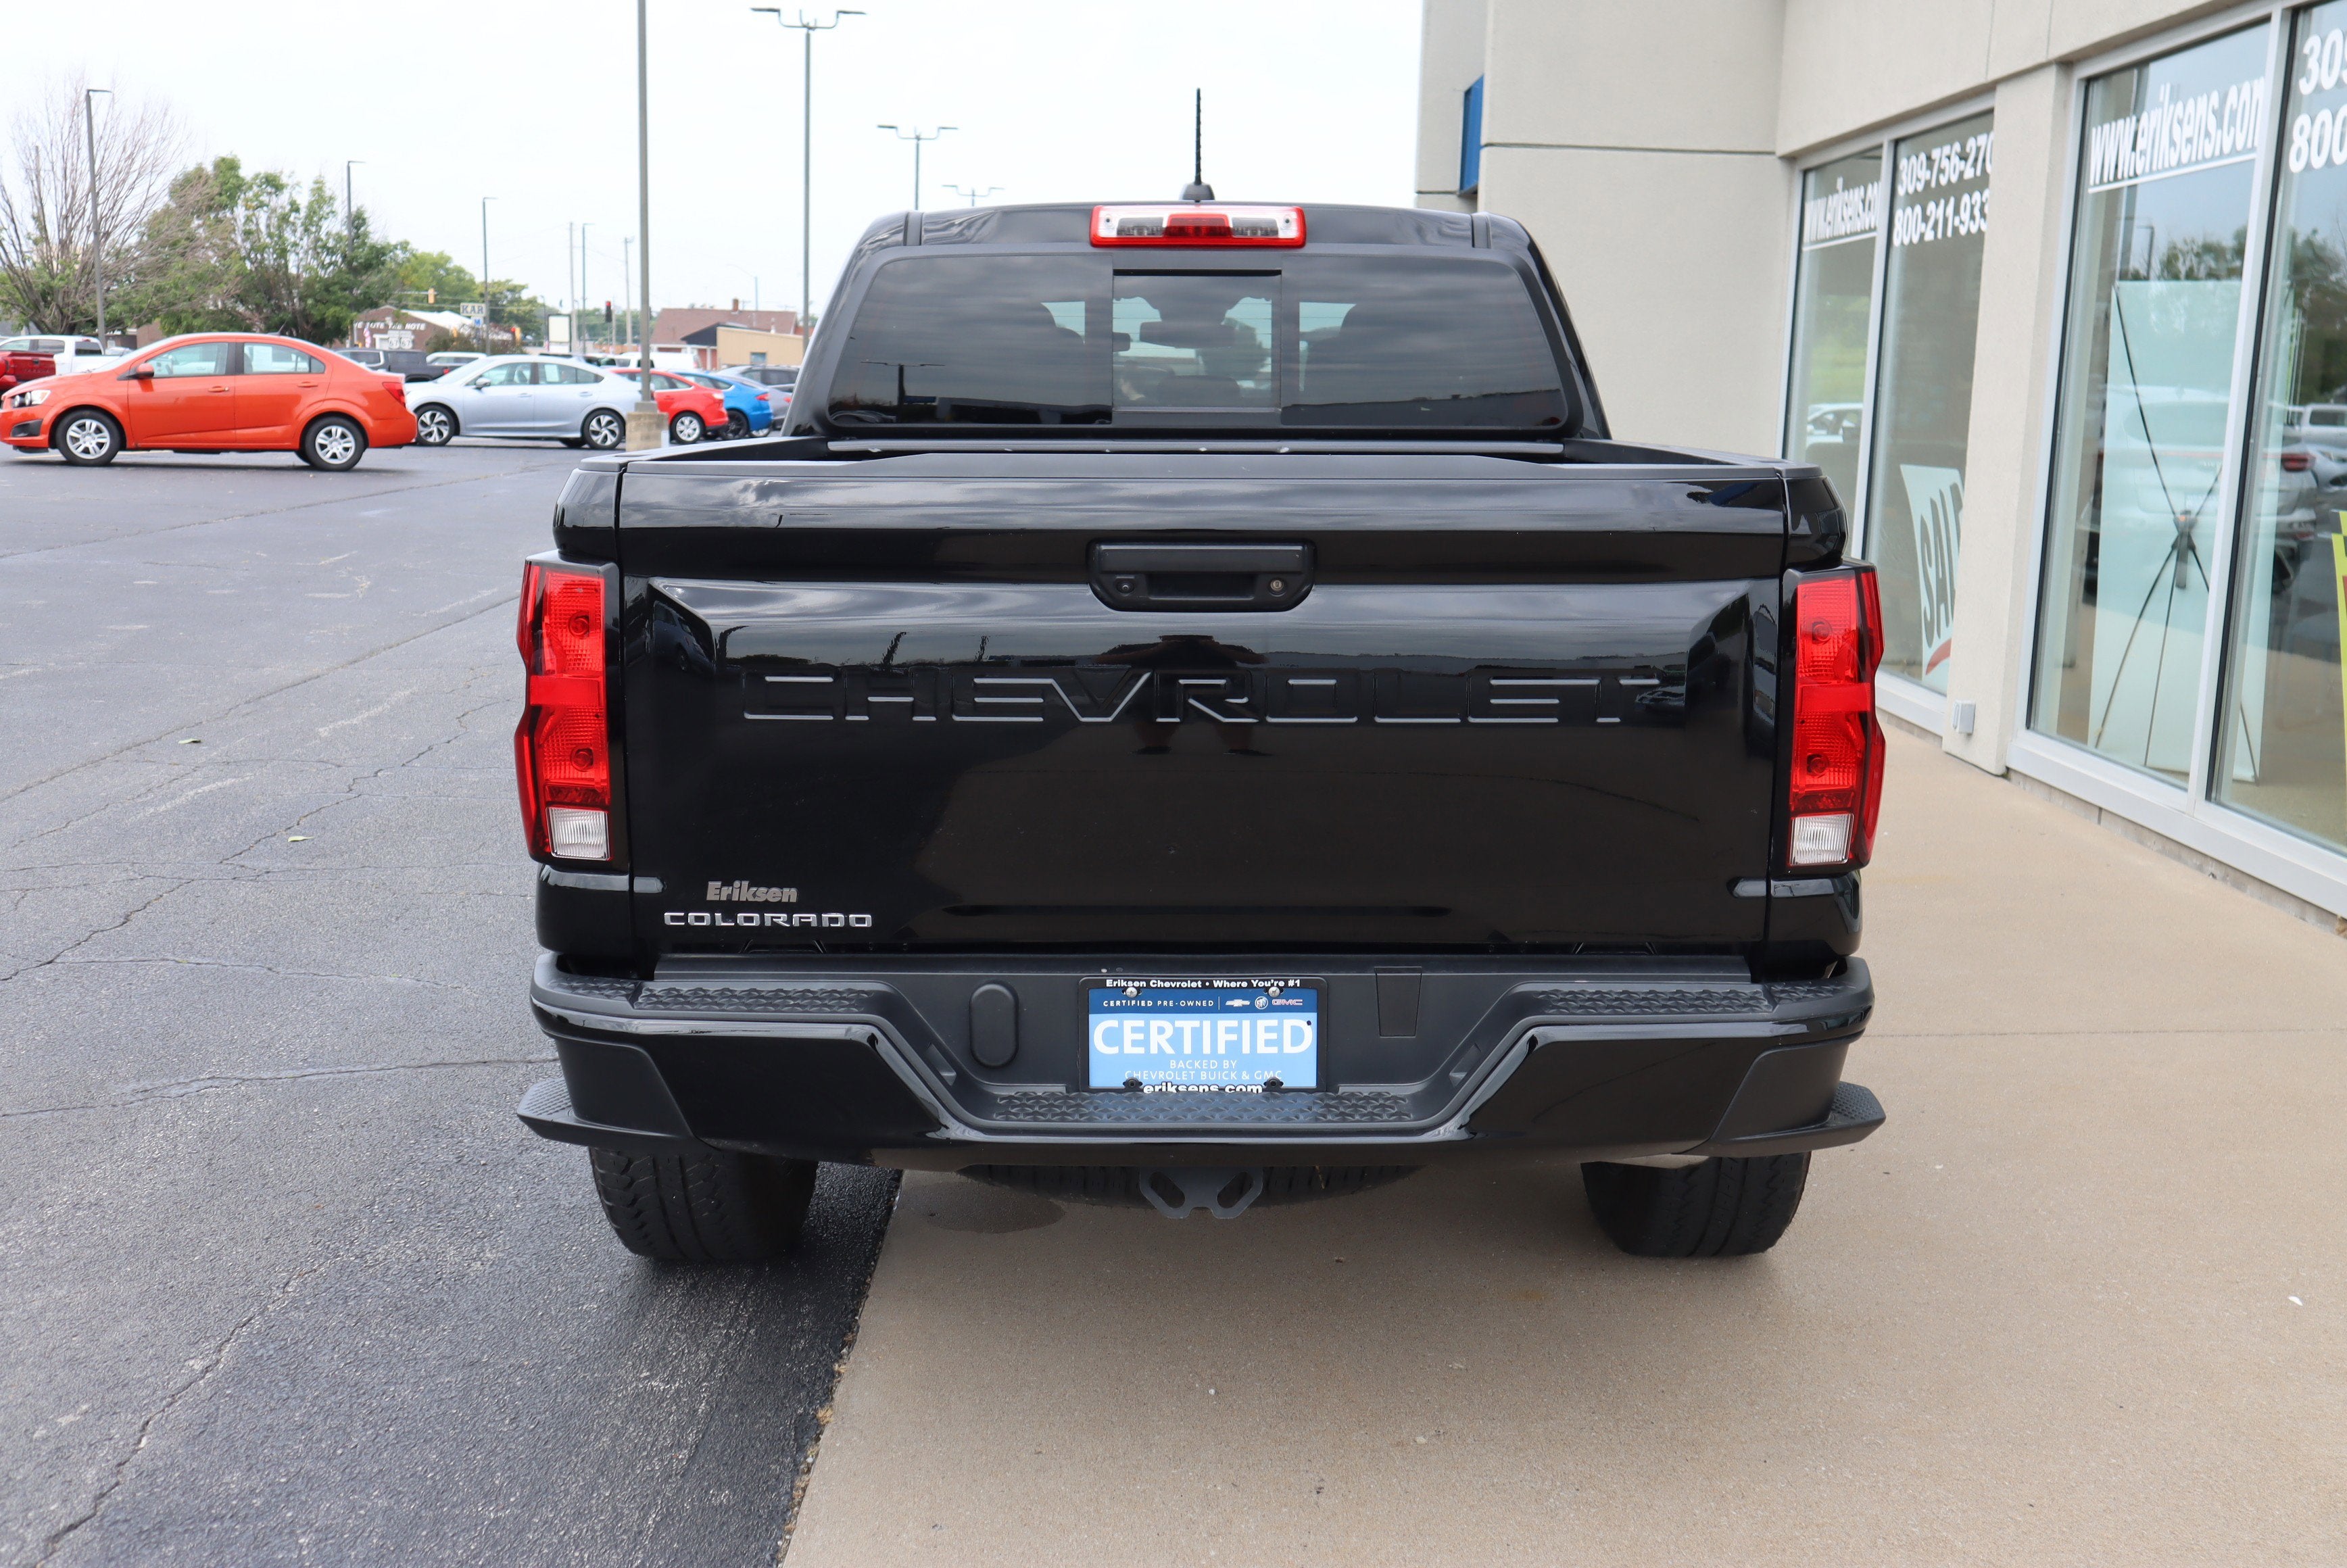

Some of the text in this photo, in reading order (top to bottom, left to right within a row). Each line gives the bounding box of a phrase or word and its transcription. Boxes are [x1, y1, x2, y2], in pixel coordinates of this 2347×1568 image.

[2299, 28, 2347, 95] 30
[462, 305, 483, 314] KAR
[405, 322, 427, 330] NOTE
[742, 666, 1662, 723] CHEVROLET
[706, 881, 798, 902] Eriksen
[664, 912, 872, 927] COLORADO
[1106, 979, 1146, 987] Eriksen
[1150, 980, 1202, 988] Chevrolet
[1251, 979, 1285, 987] You're
[1288, 979, 1301, 987] #1
[1093, 1019, 1313, 1054] CERTIFIED
[1169, 1060, 1238, 1069] BACKED BY
[1125, 1071, 1282, 1080] CHEVROLET BUICK & GMC
